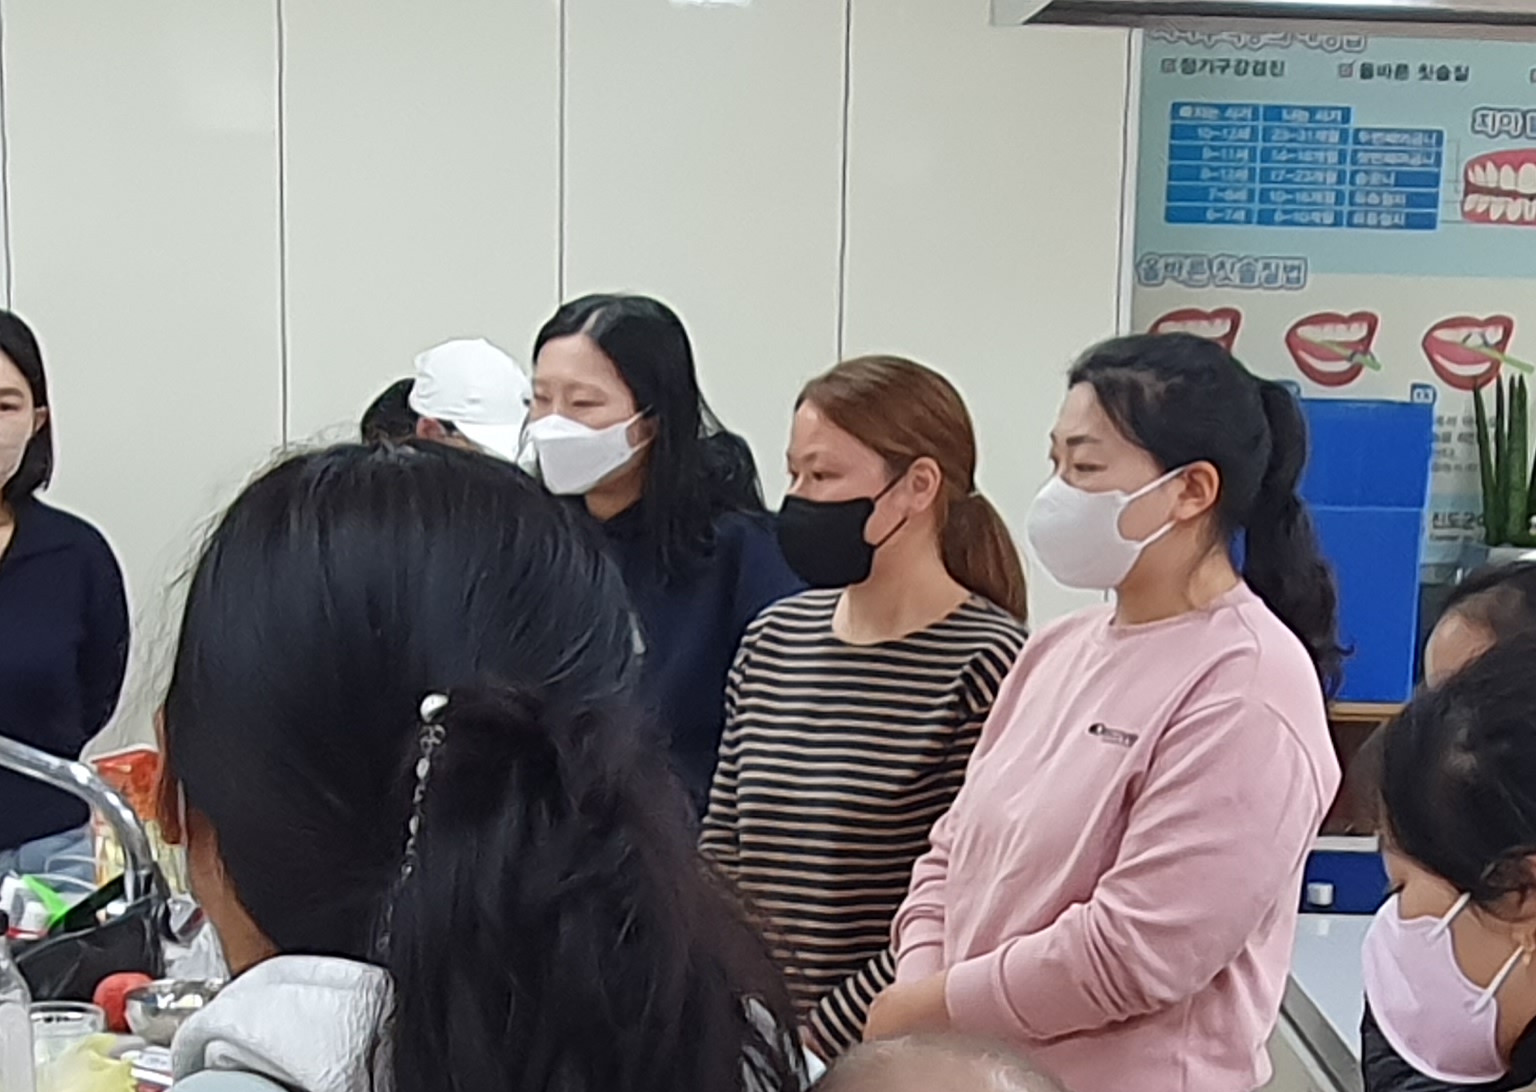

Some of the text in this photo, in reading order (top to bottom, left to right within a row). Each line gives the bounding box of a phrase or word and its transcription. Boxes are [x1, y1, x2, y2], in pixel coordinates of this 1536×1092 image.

[1360, 63, 1470, 82] 올바른 칫솔질
[1474, 109, 1522, 137] 치아
[1138, 254, 1307, 289] 올바른 칫솔질법
